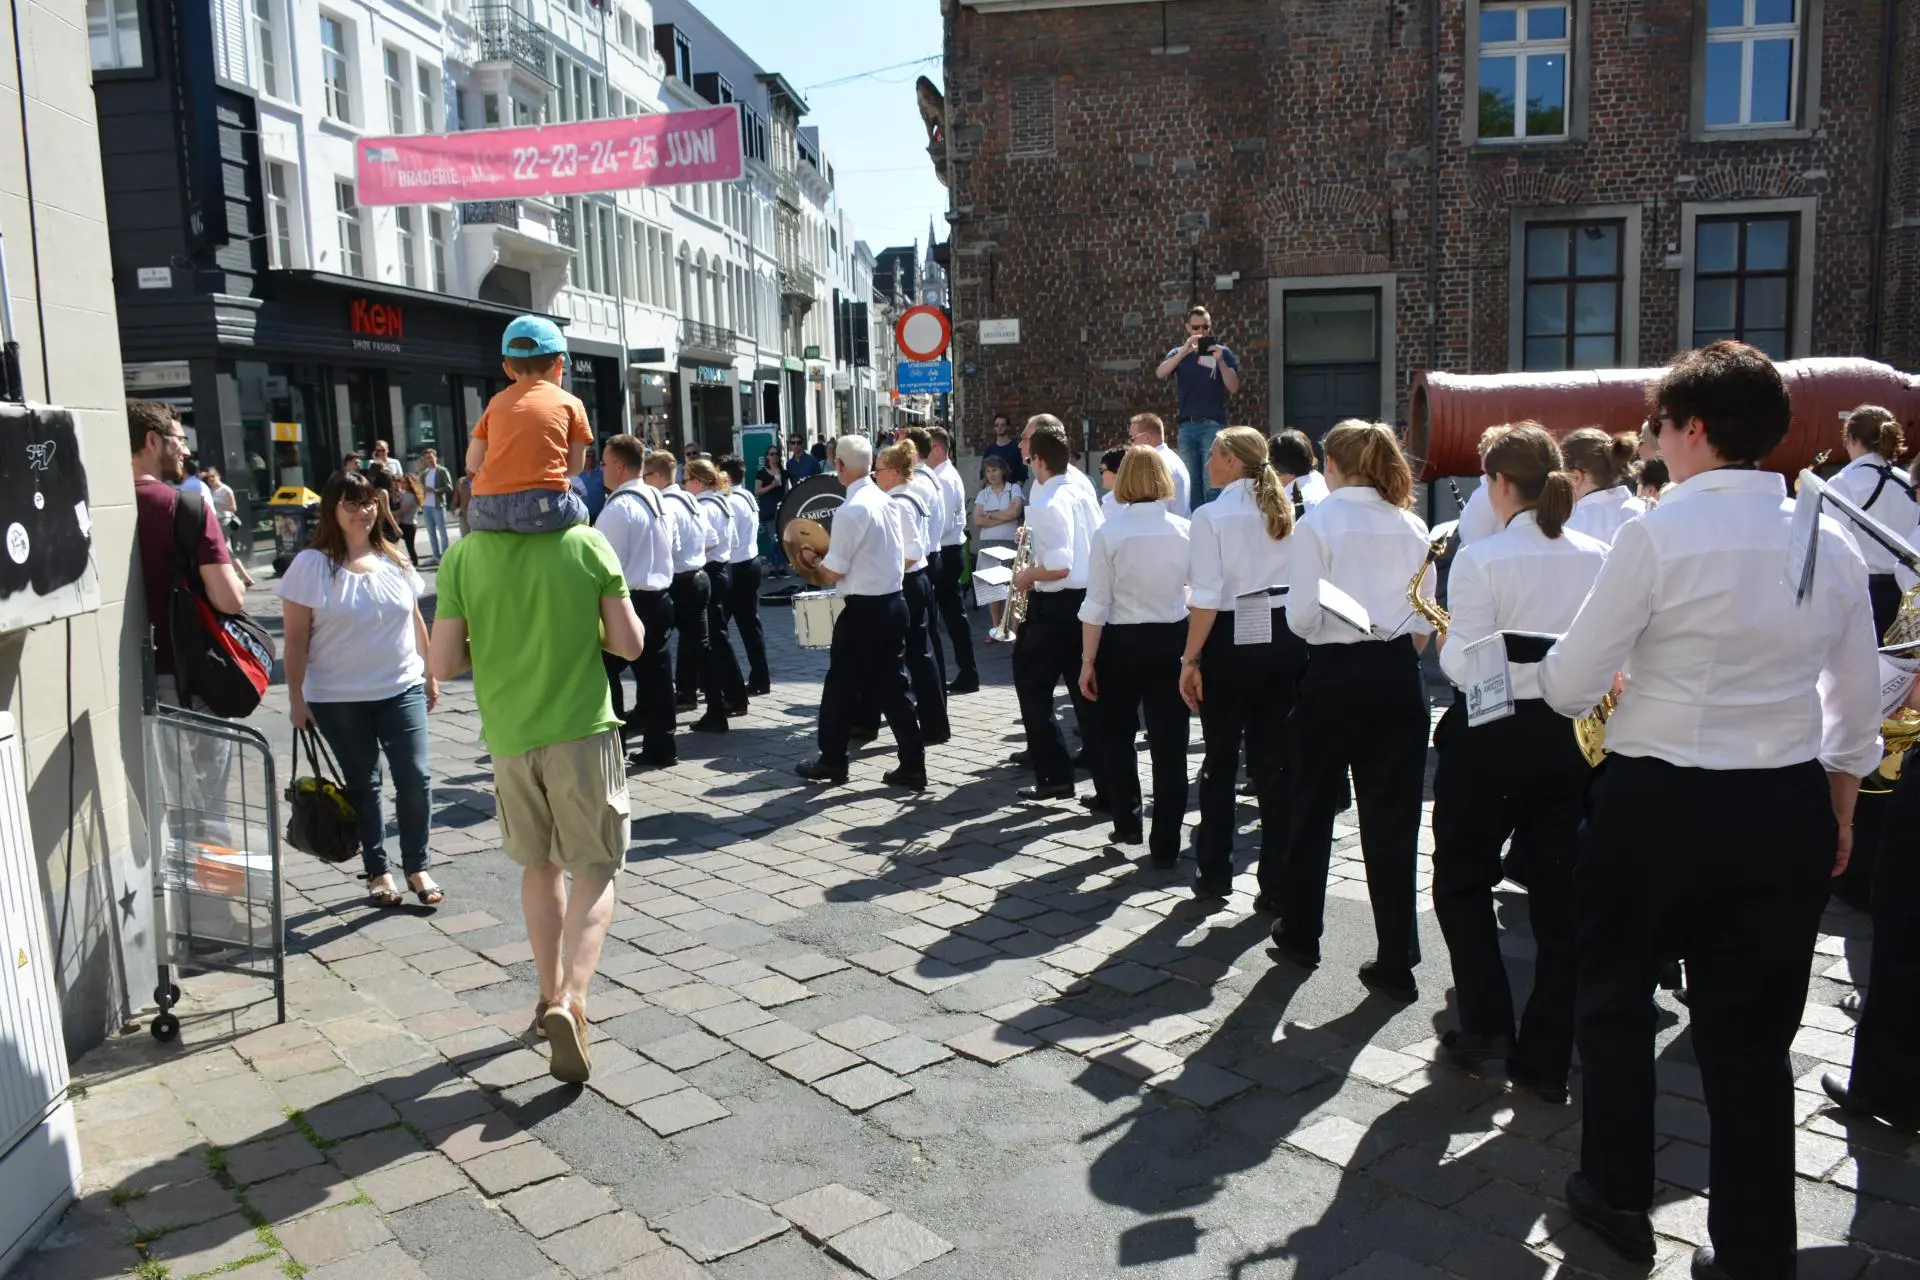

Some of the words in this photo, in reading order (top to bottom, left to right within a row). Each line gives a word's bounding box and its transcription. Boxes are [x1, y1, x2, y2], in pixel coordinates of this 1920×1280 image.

[398, 167, 460, 187] BRADERIE
[513, 134, 659, 180] 22-23-24-25
[665, 128, 717, 167] JUNI
[352, 339, 371, 350] SHOE
[372, 341, 401, 352] FASHION
[801, 507, 837, 520] AMICIT
